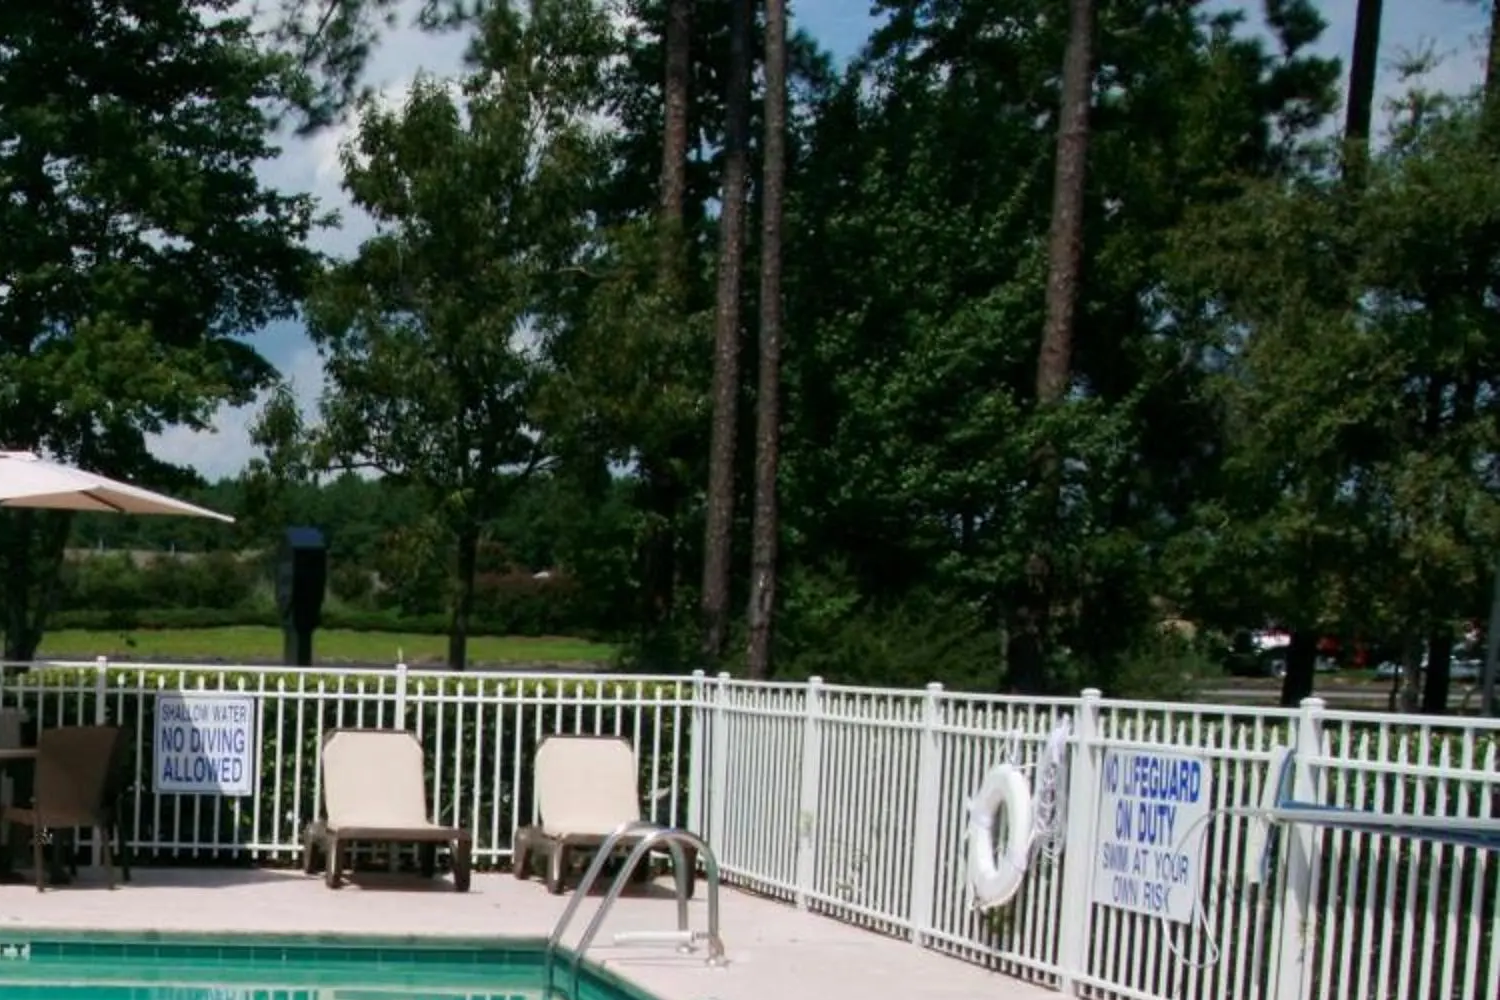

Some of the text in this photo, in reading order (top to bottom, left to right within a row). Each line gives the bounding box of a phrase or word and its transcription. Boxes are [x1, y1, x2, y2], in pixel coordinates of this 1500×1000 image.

[161, 704, 246, 722] SHALLOW WATER
[161, 726, 245, 753] NO DIVING
[163, 757, 243, 783] ALLOWED
[1104, 753, 1202, 803] NO LIFEGUARD
[1116, 800, 1177, 848] ON DUTY
[1102, 842, 1189, 884] SWIM AT YOUR
[1113, 875, 1173, 912] OWN RISK
